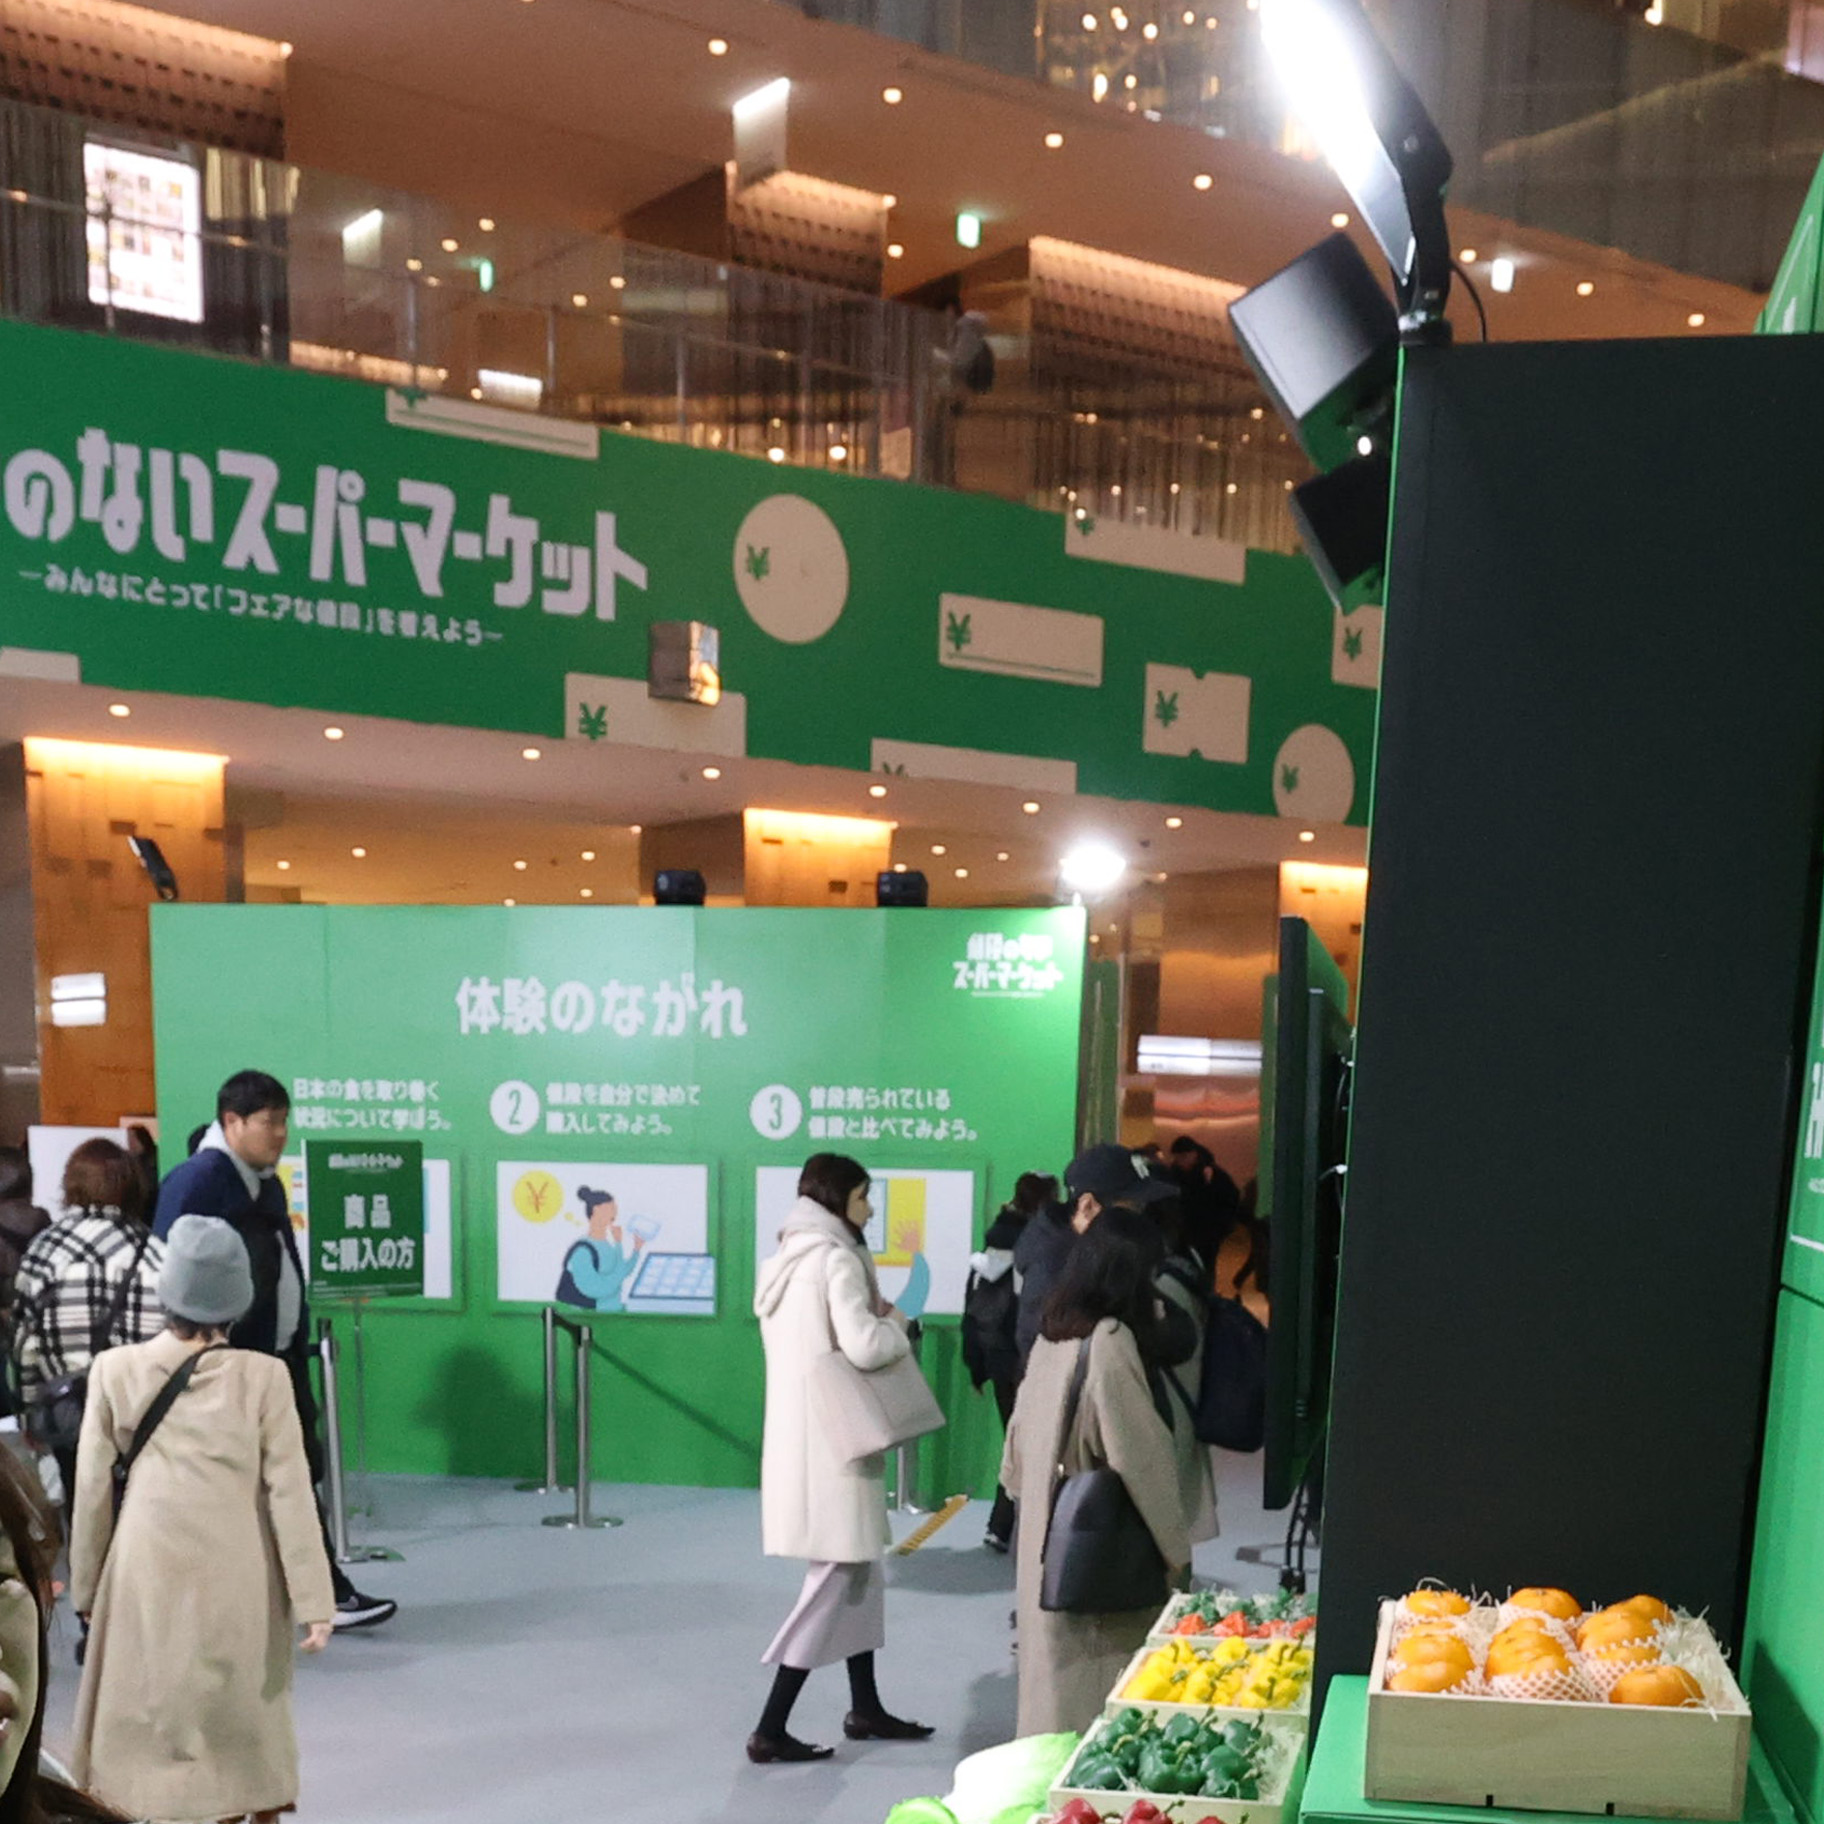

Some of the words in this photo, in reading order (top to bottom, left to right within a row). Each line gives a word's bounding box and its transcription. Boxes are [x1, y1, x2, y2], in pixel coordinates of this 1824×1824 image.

[455, 972, 748, 1039] 体験のながれ
[321, 1237, 416, 1272] ご購入の方
